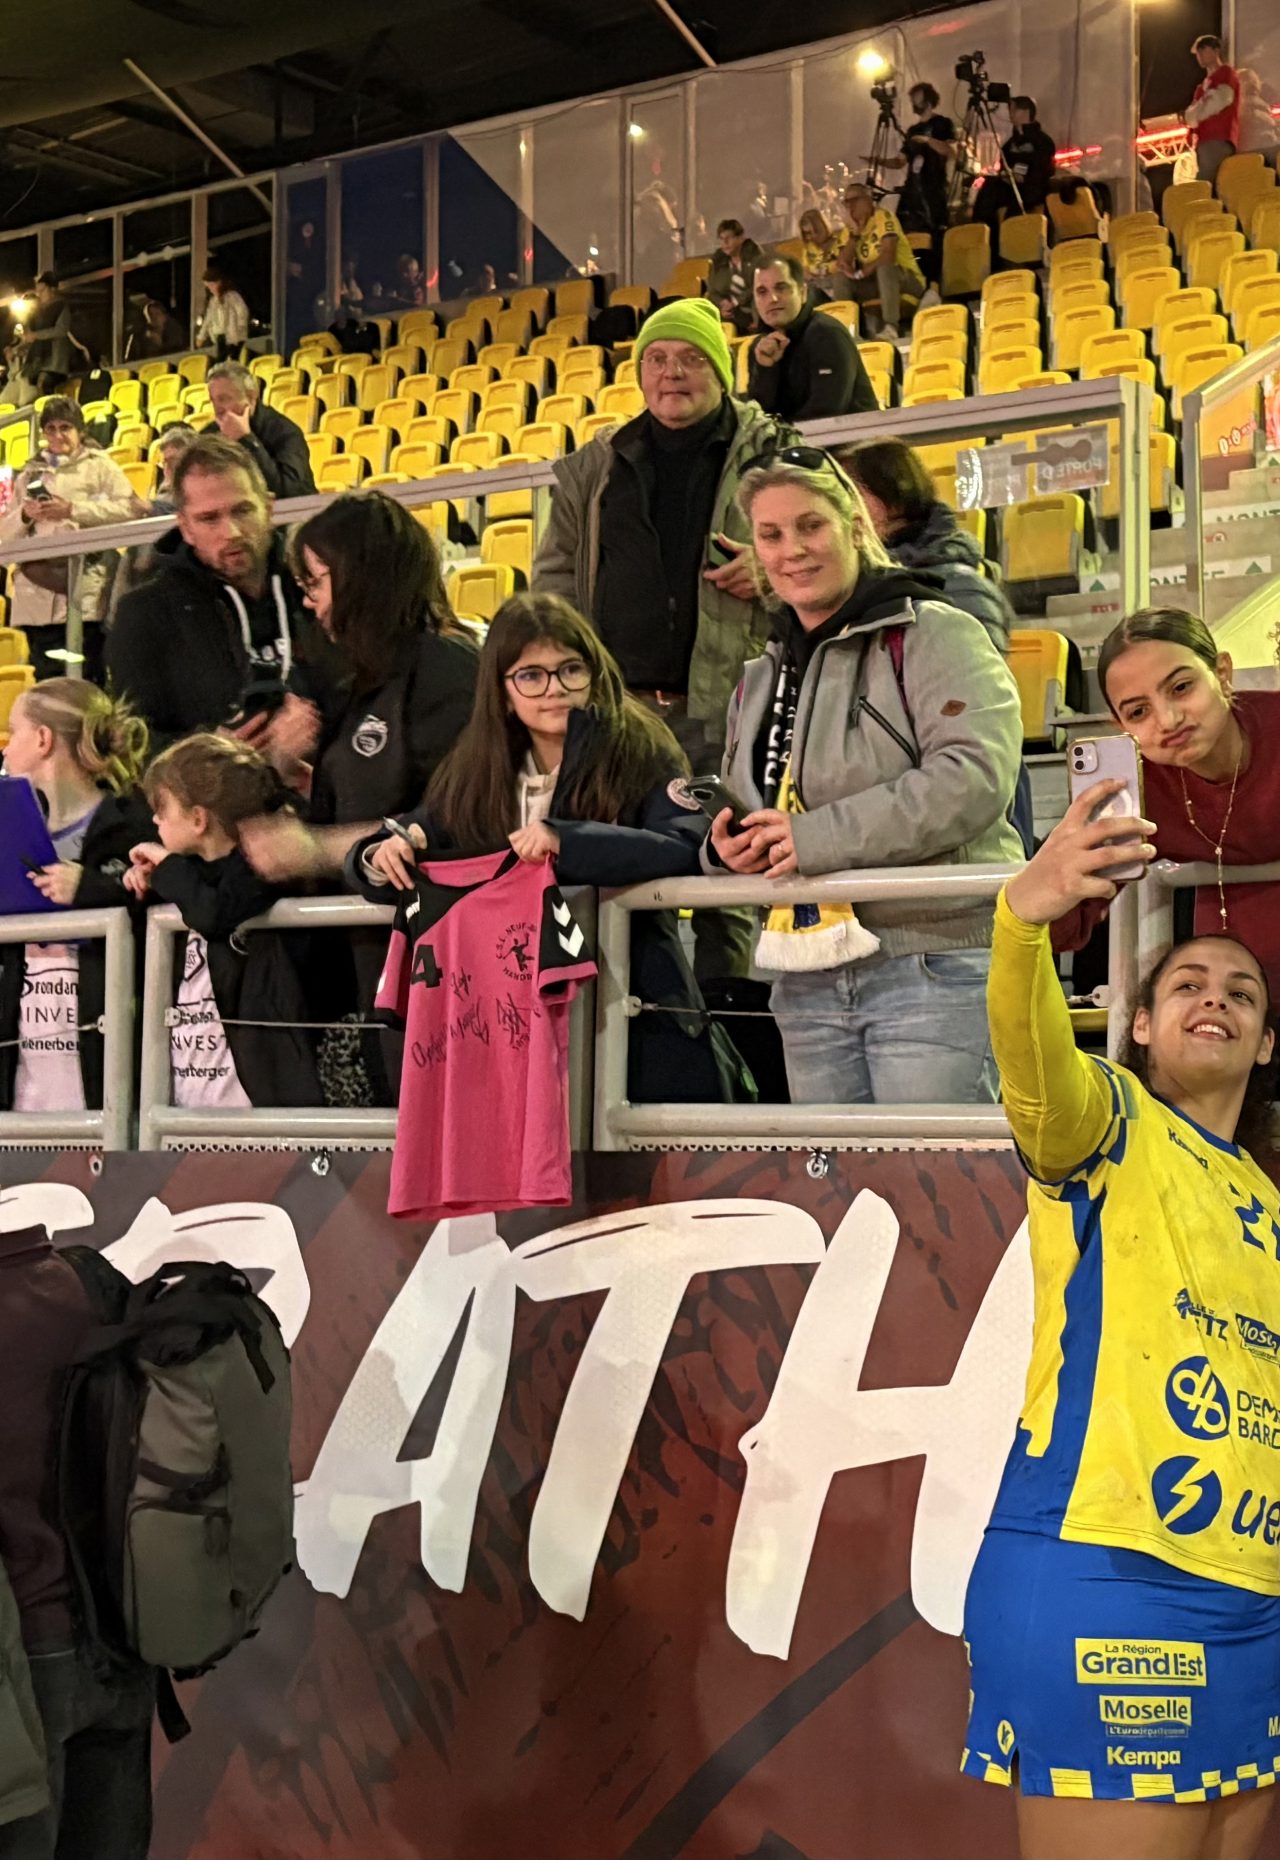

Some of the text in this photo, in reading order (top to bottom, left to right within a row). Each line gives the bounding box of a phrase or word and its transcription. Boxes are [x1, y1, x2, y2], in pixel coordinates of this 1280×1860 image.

[1104, 1644, 1162, 1655] La Région
[1104, 1699, 1189, 1720] Moselle
[1106, 1745, 1182, 1771] Kempa
